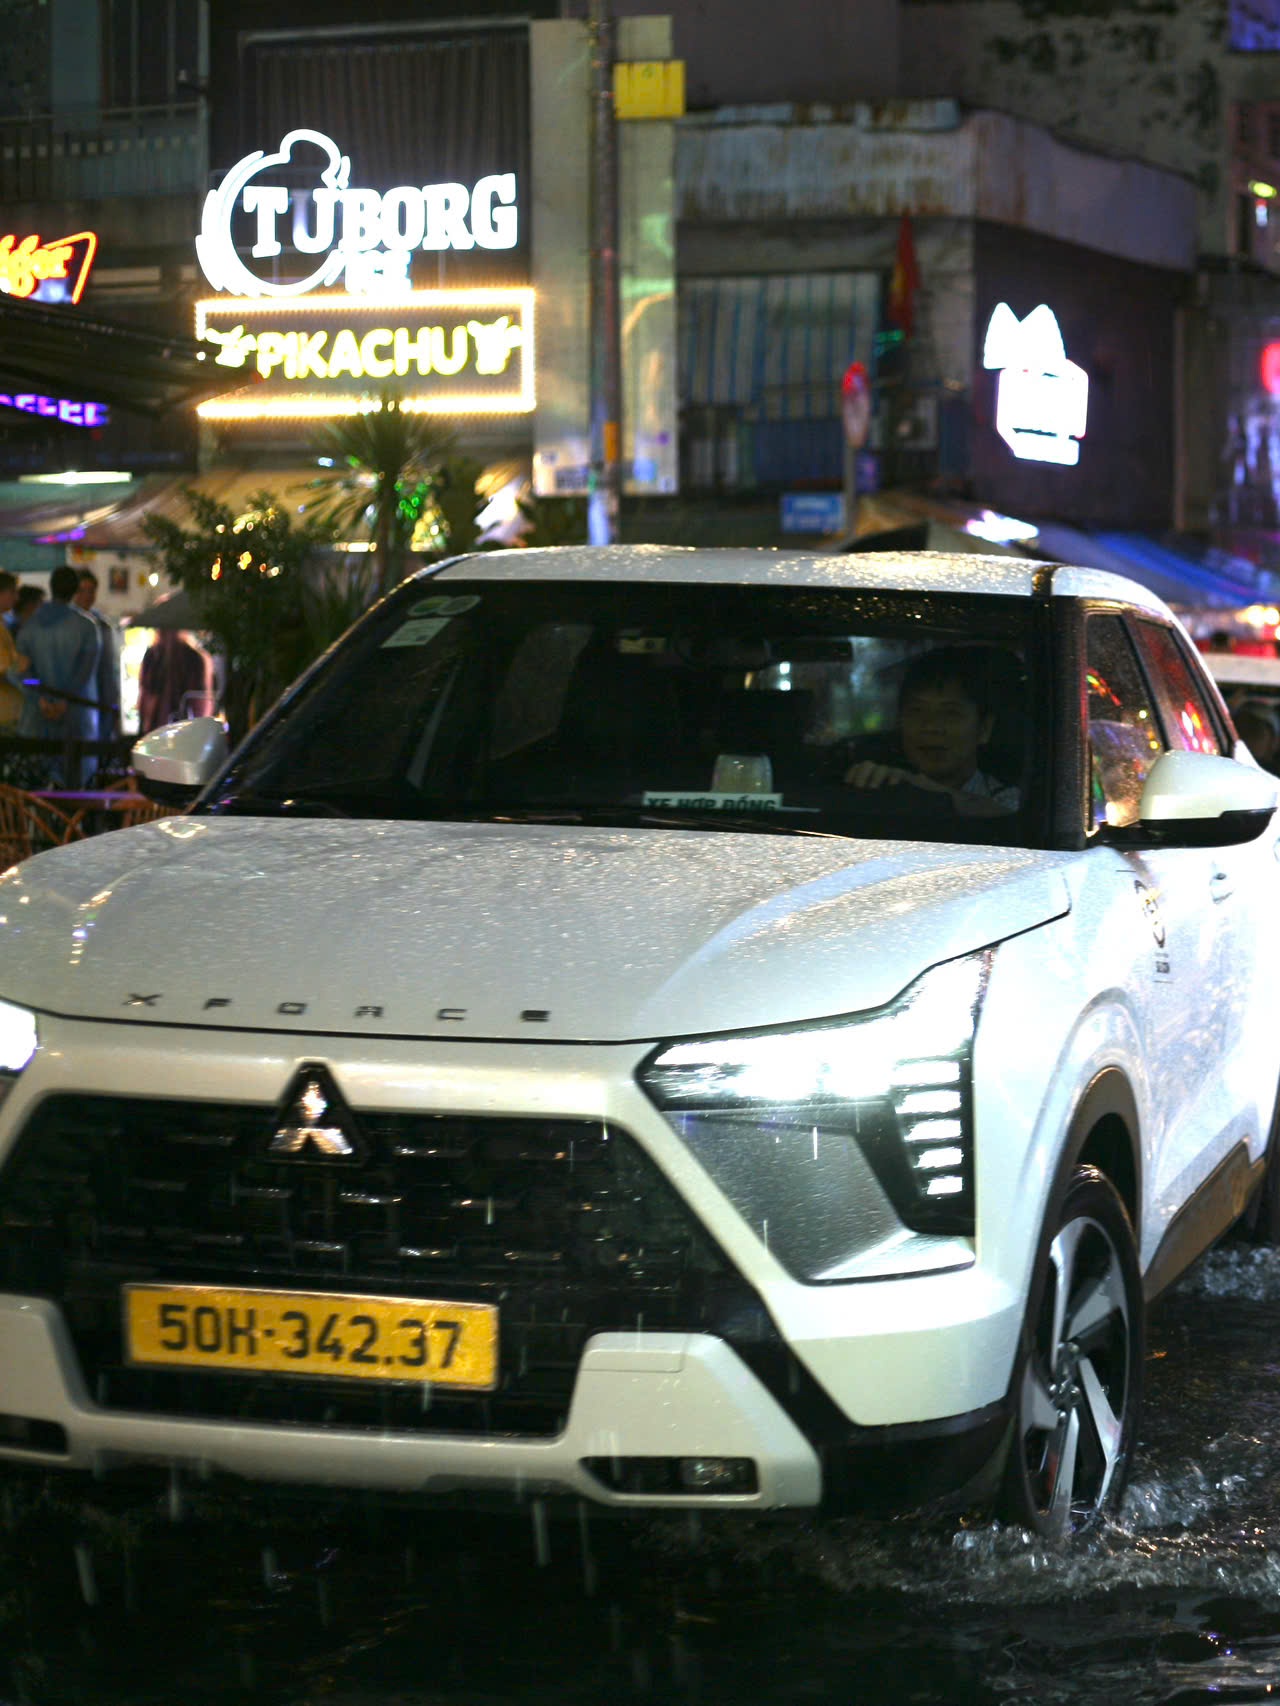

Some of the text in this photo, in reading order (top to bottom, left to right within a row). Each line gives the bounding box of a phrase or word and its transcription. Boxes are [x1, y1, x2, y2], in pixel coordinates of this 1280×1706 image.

[242, 172, 518, 258] TUBORG
[257, 325, 469, 379] PIKACHU
[121, 993, 552, 1023] XFORCE
[158, 1303, 464, 1369] 50H-342.37
